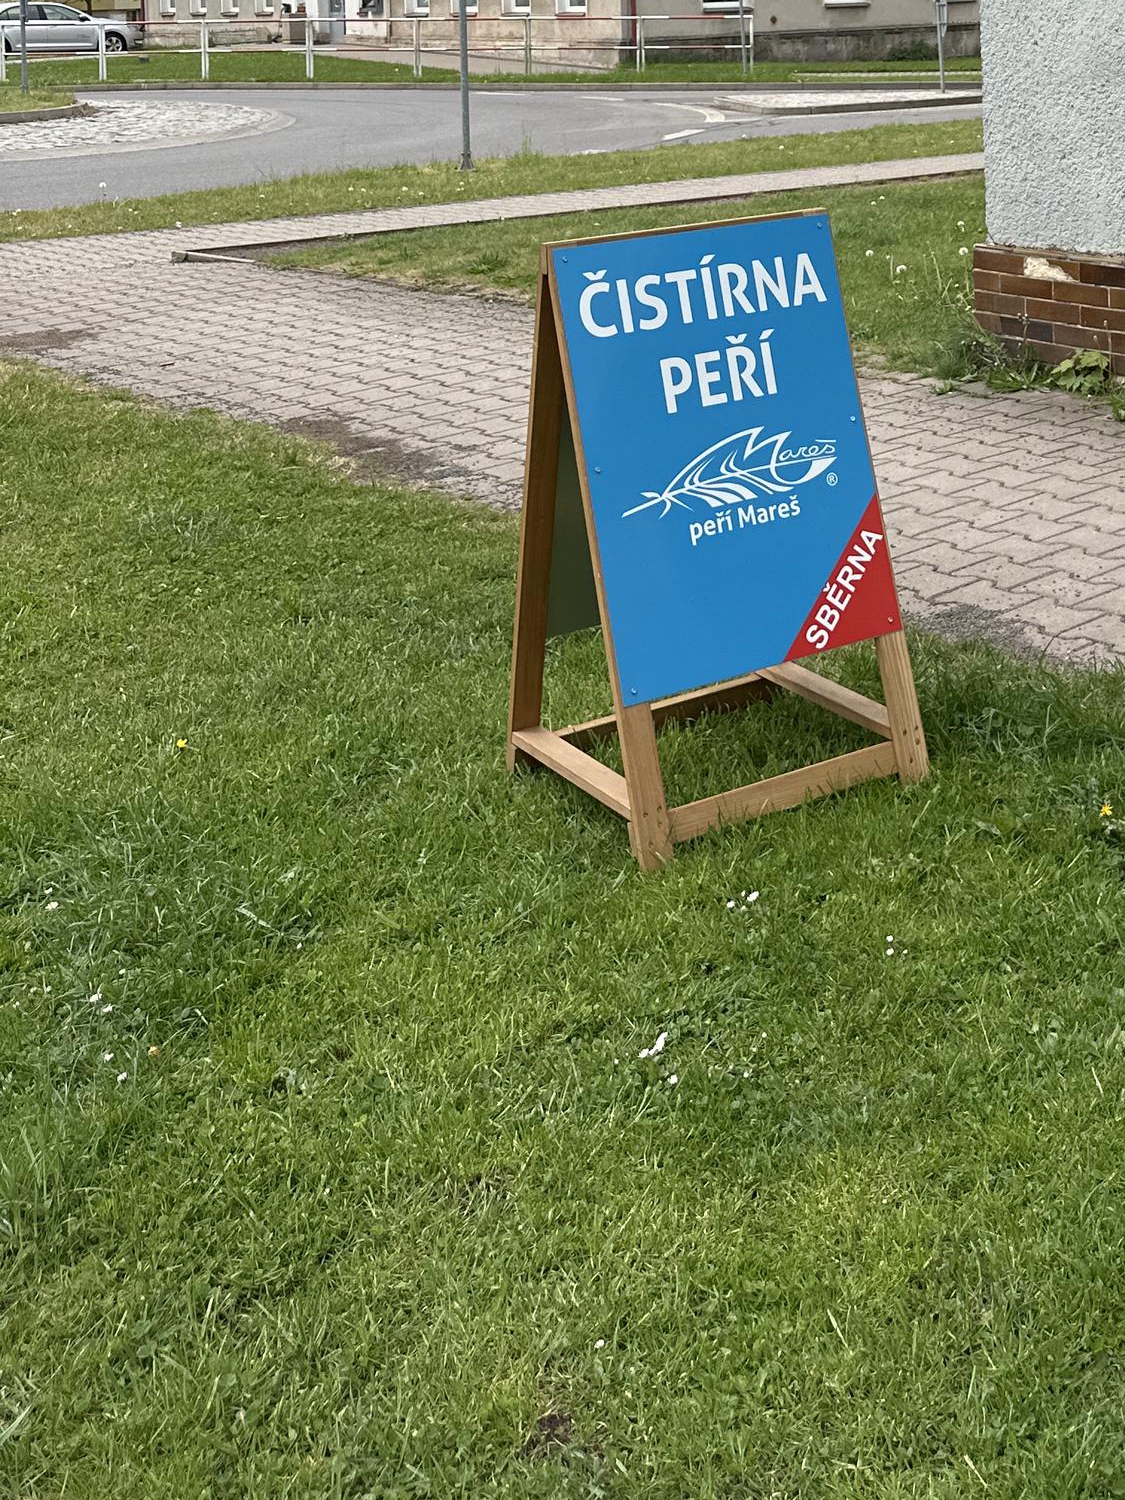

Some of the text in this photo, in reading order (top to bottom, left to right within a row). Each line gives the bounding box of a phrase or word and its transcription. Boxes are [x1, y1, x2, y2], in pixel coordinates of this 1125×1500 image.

[579, 253, 828, 338] ČISTÍRNA
[659, 328, 779, 414] PEŘÍ
[689, 494, 802, 546] peří Mareš
[805, 528, 884, 650] SBĚRNA
